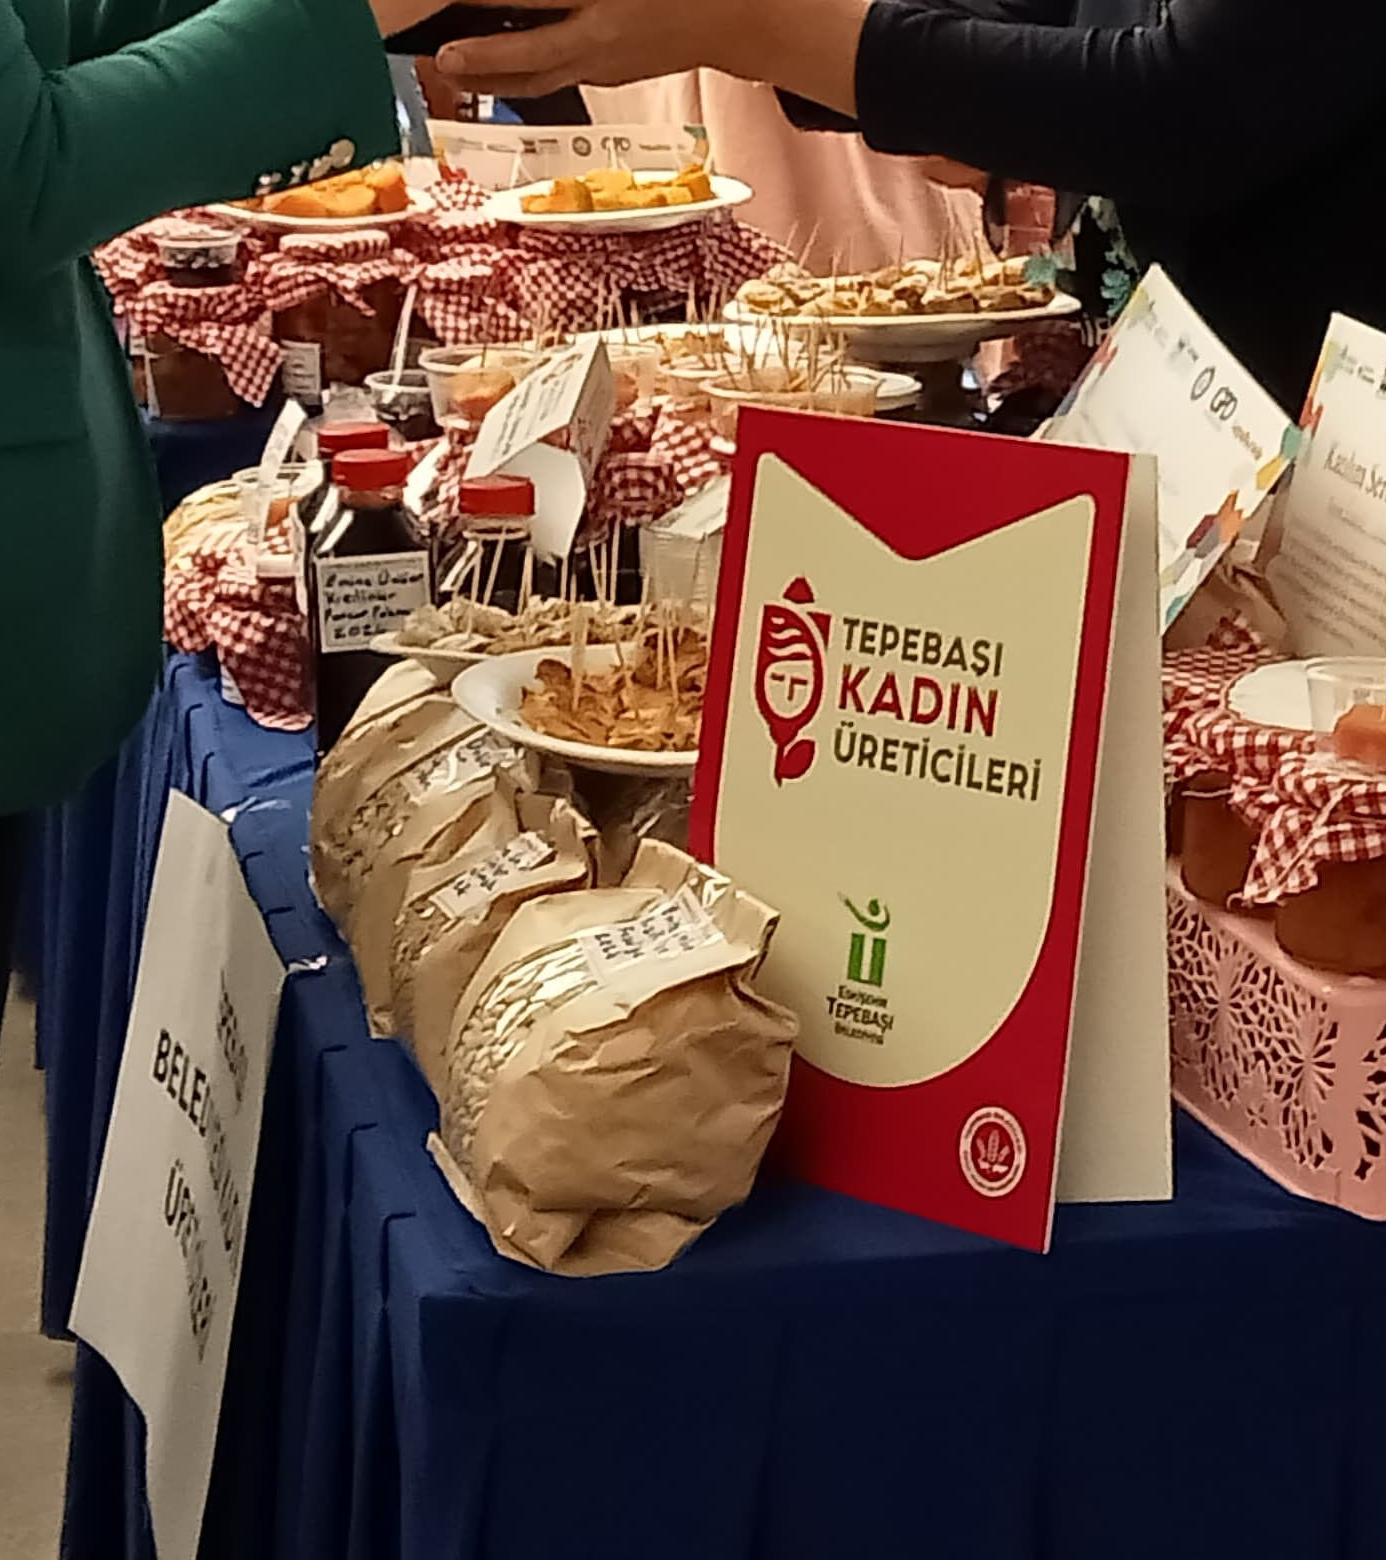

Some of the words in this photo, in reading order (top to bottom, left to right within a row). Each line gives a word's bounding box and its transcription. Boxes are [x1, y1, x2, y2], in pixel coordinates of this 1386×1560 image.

[842, 617, 1004, 677] TEPEBAŞI
[838, 663, 999, 737] KADIN
[833, 721, 1042, 801] ÜRETİCİLERİ
[825, 995, 895, 1034] TEPEBAŞI
